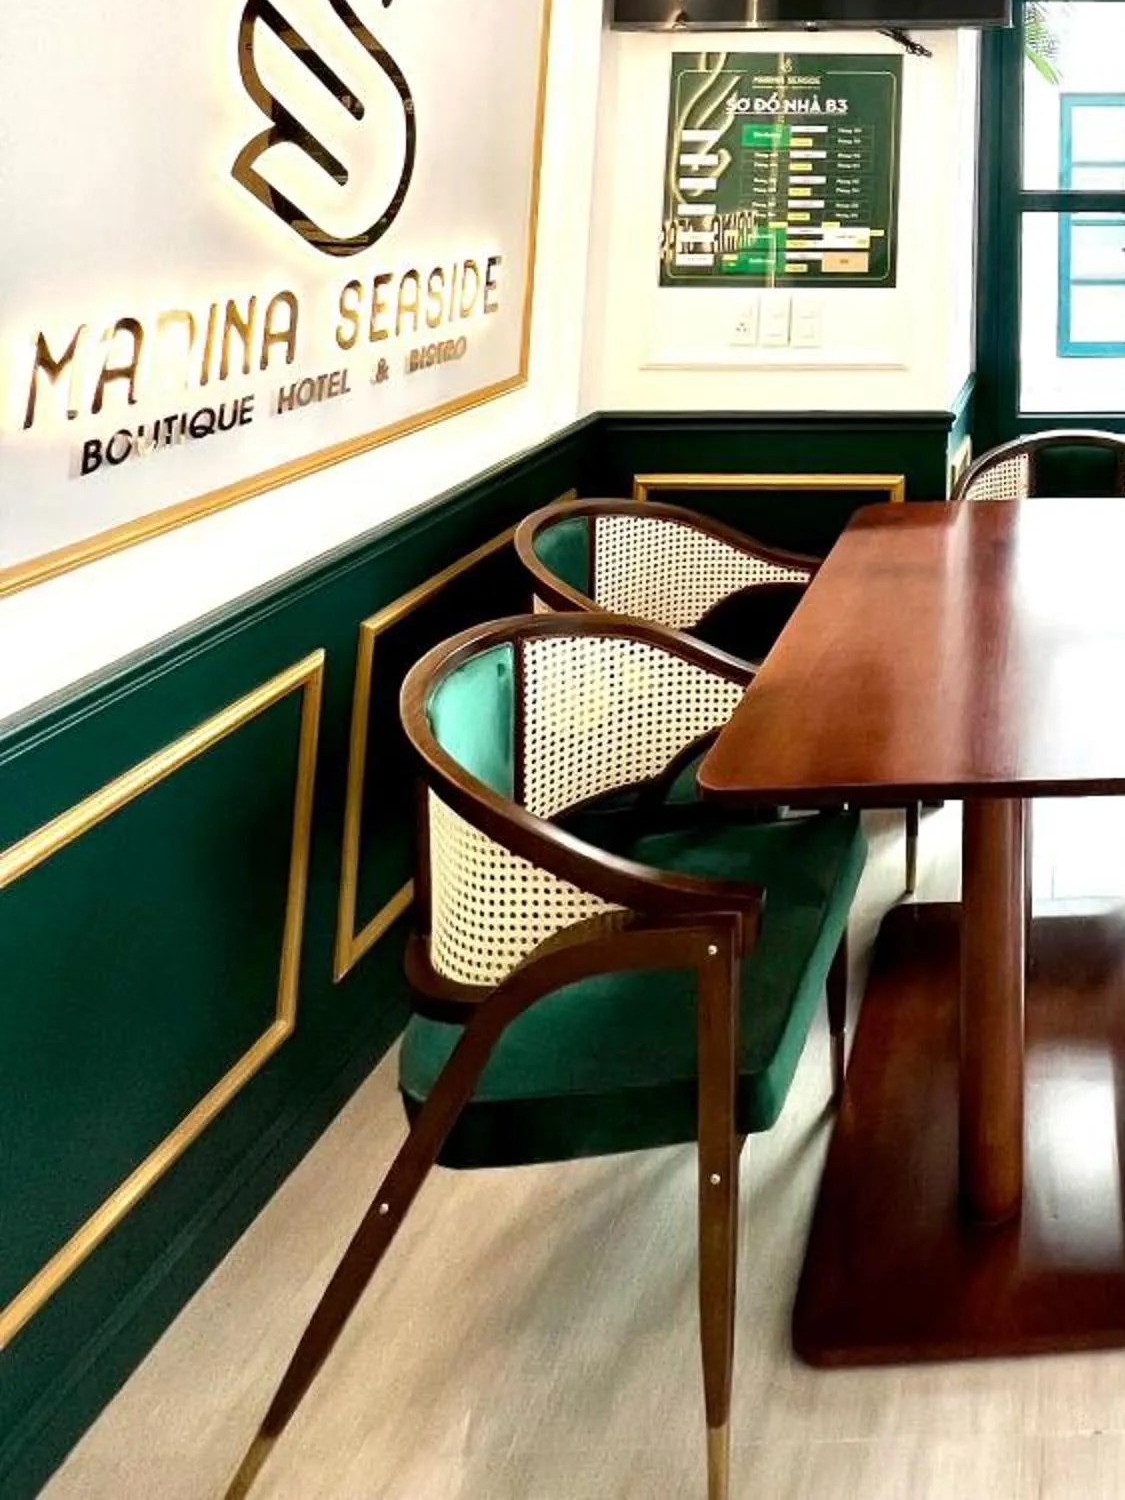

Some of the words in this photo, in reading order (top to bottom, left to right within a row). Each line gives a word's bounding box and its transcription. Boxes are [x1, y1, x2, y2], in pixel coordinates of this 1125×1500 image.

[335, 255, 501, 350] SEASIDE
[78, 394, 255, 476] BOUTIQUE
[275, 367, 352, 415] HOTEL
[372, 357, 390, 384] &
[405, 335, 468, 374] BISTRO
